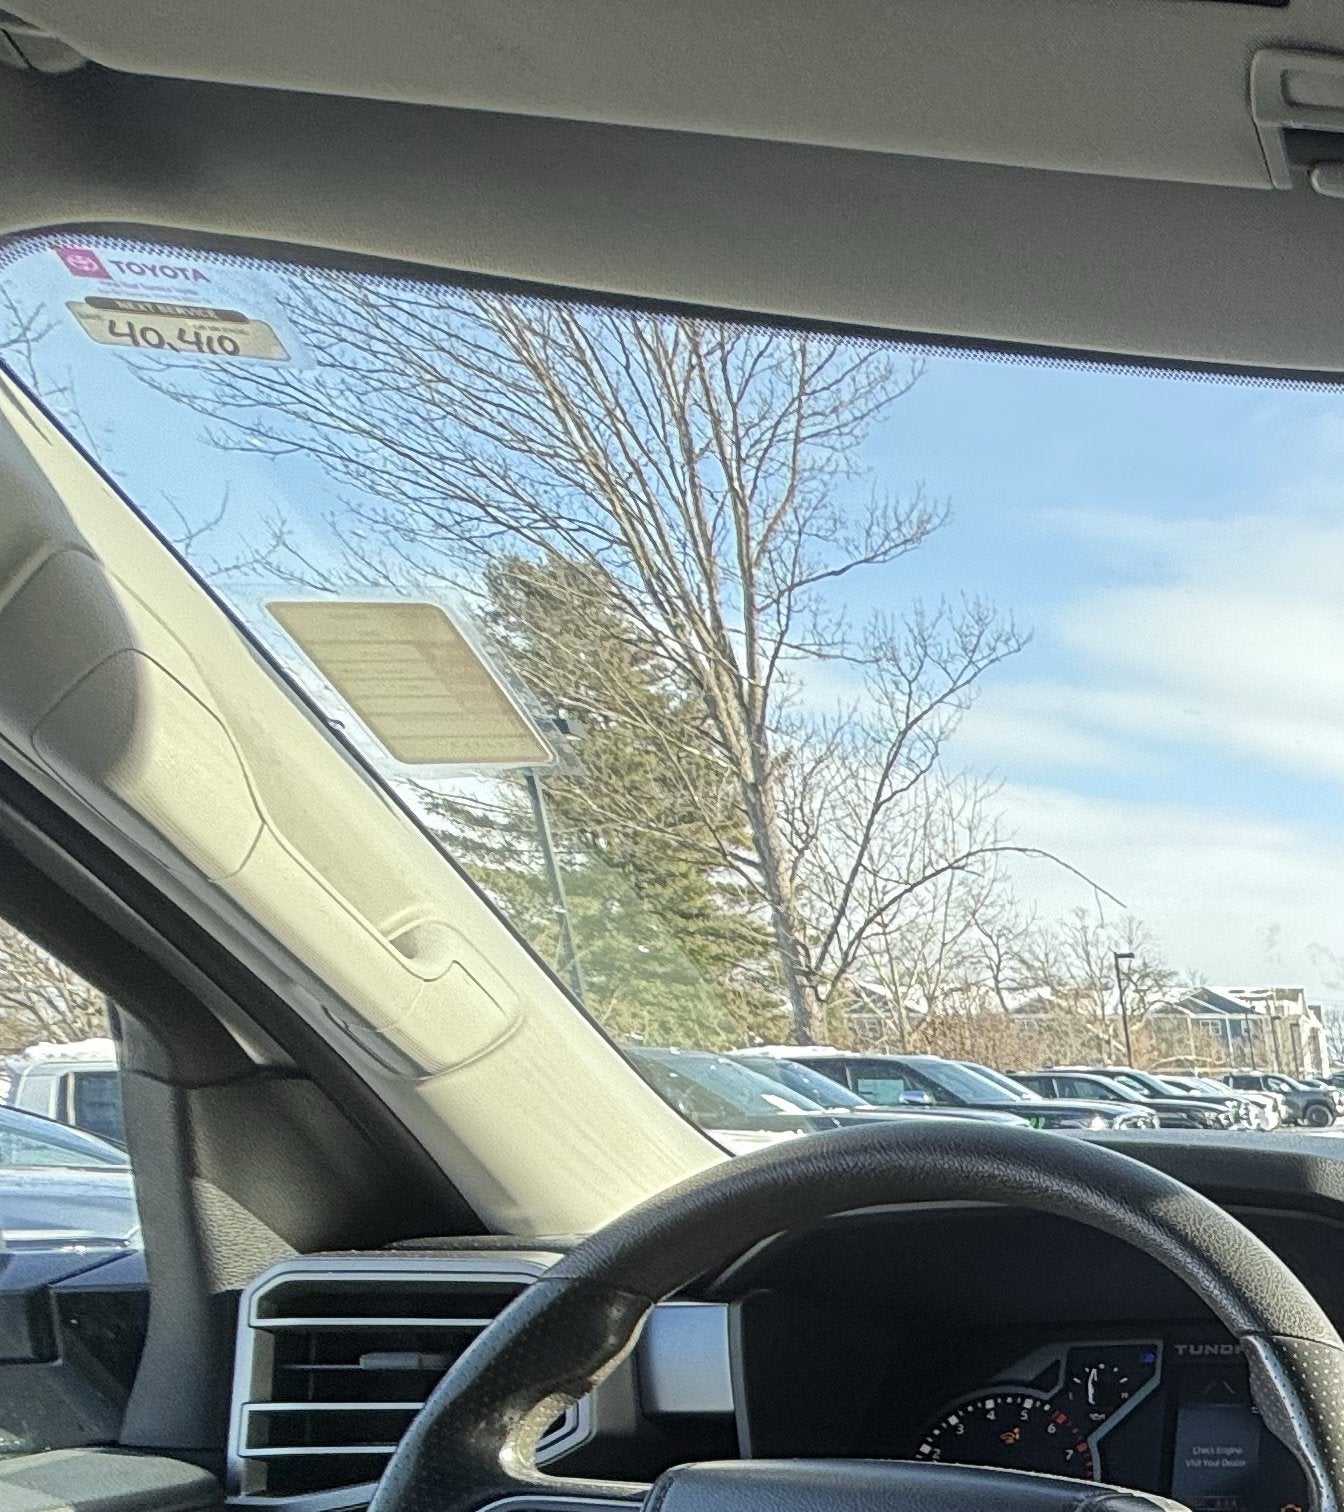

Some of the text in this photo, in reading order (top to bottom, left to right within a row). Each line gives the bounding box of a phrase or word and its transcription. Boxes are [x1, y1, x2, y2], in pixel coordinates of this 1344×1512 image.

[108, 259, 212, 284] TOYOTA
[108, 319, 241, 357] 40,410
[986, 1410, 996, 1420] 4
[1020, 1409, 1029, 1420] 5
[956, 1424, 965, 1435] 3
[1047, 1423, 1057, 1434] 6
[932, 1449, 941, 1460] 2
[1065, 1449, 1074, 1461] 7
